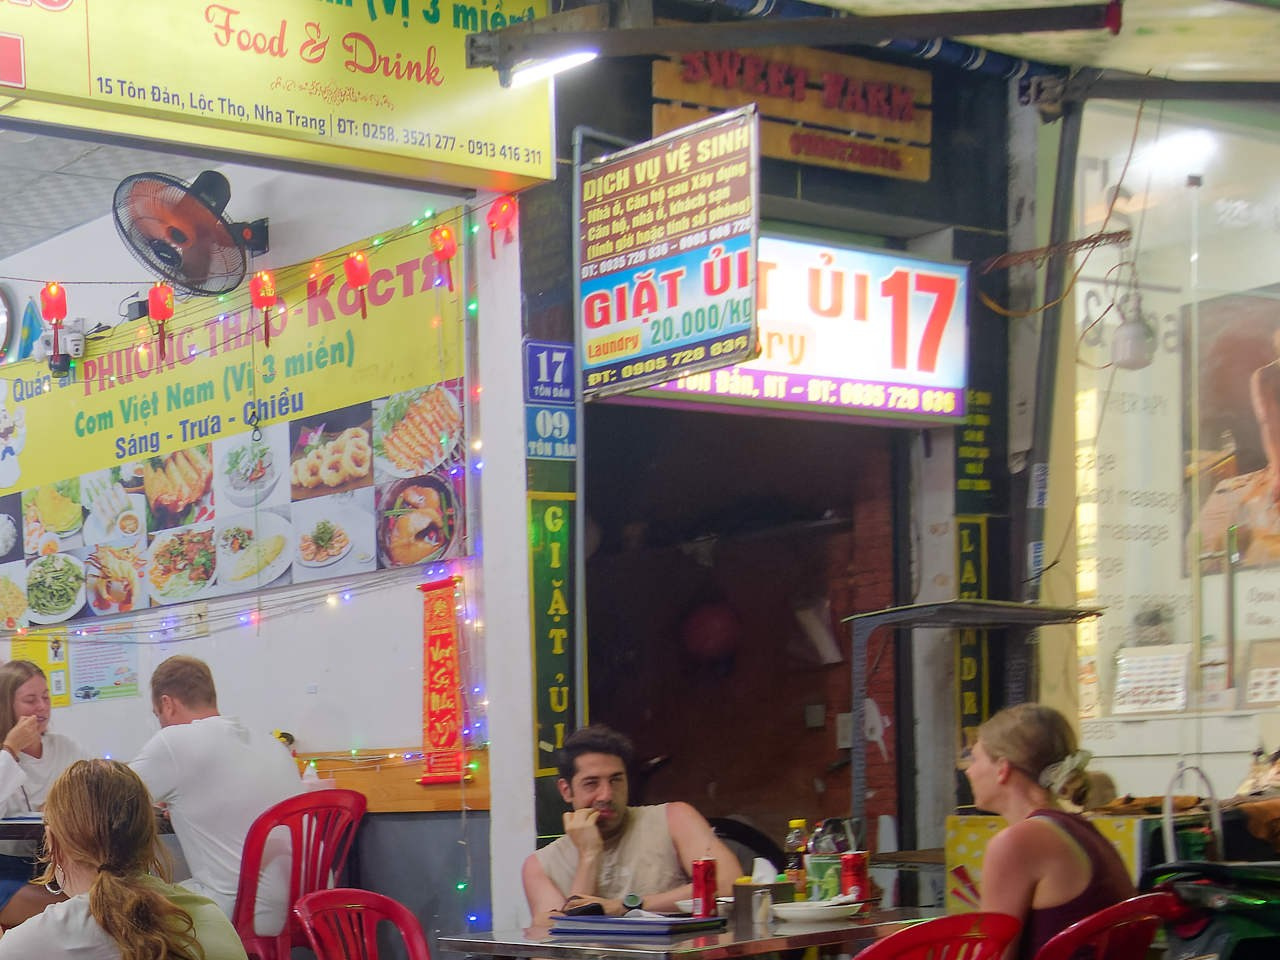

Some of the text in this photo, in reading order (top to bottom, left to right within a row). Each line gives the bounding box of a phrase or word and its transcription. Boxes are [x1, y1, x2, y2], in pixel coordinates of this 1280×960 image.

[204, 4, 445, 87] Food & Drink
[97, 76, 113, 94] 15
[117, 79, 146, 100] Tôn
[189, 92, 214, 115] Lộc
[218, 97, 250, 122] Thọ,
[254, 104, 283, 123] Nha
[286, 109, 326, 135] Trang
[337, 118, 358, 136] ĐT:
[362, 122, 399, 143] 0258.
[403, 129, 432, 147] 3521
[435, 134, 456, 151] 277
[468, 139, 496, 158] 0913
[499, 145, 521, 161] 416
[524, 148, 542, 165] 311
[583, 167, 630, 203] DỊCH
[634, 156, 661, 184] VỤ
[665, 142, 693, 174] VỆ
[696, 126, 750, 164] SINH
[584, 270, 684, 330] GIẶT
[703, 246, 750, 297] ỦI
[808, 252, 868, 321] ỦI
[880, 269, 958, 374] 17
[536, 350, 566, 384] 17
[587, 334, 639, 359] Laundry
[587, 368, 617, 387] ĐT:
[115, 430, 160, 459] Sáng
[179, 414, 221, 443] Trưa
[243, 386, 305, 427] Chiều
[120, 390, 159, 426] Việt
[166, 379, 214, 412] Nam
[262, 354, 275, 384] 3
[535, 409, 570, 439] 09
